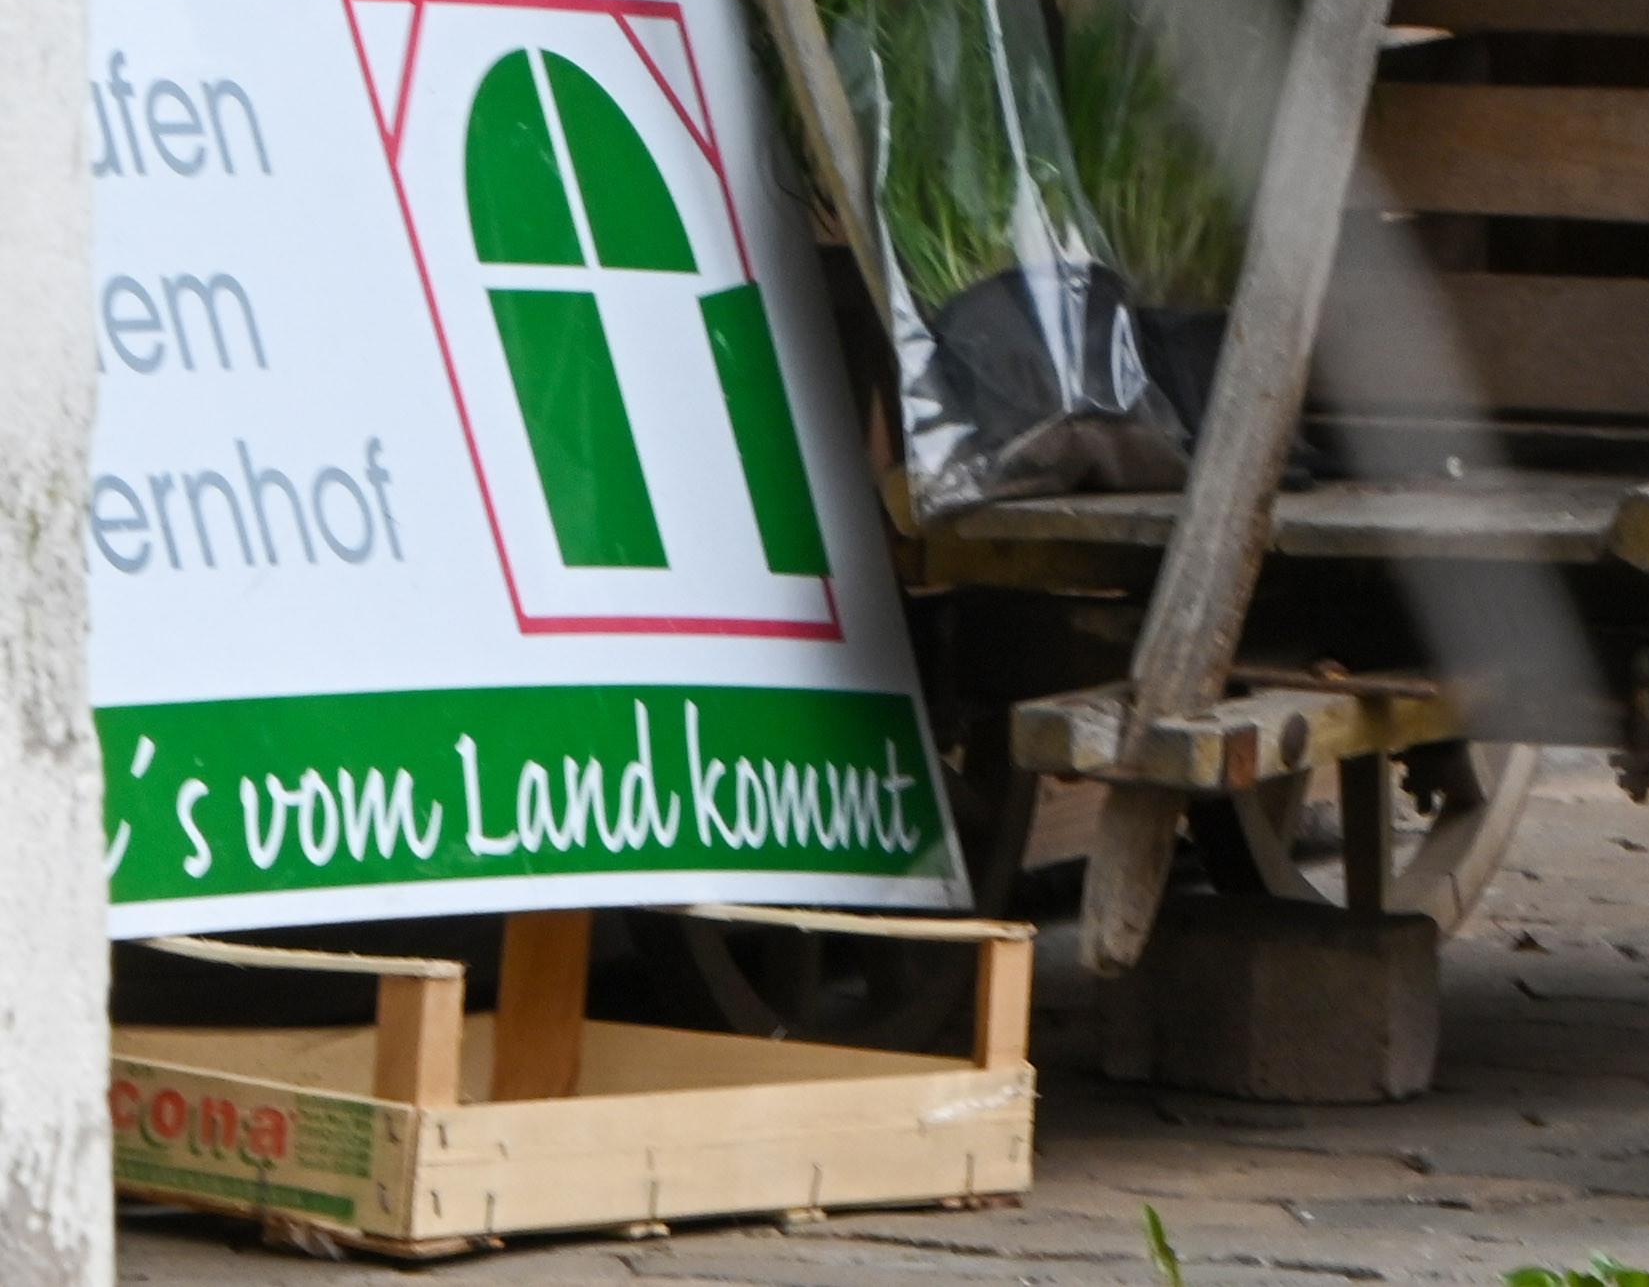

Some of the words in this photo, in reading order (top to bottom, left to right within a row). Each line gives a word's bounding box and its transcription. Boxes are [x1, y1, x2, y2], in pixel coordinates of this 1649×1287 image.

[89, 436, 402, 574] ernhof
[239, 766, 443, 870] vom
[455, 698, 681, 857] Land
[685, 697, 921, 854] kommt
